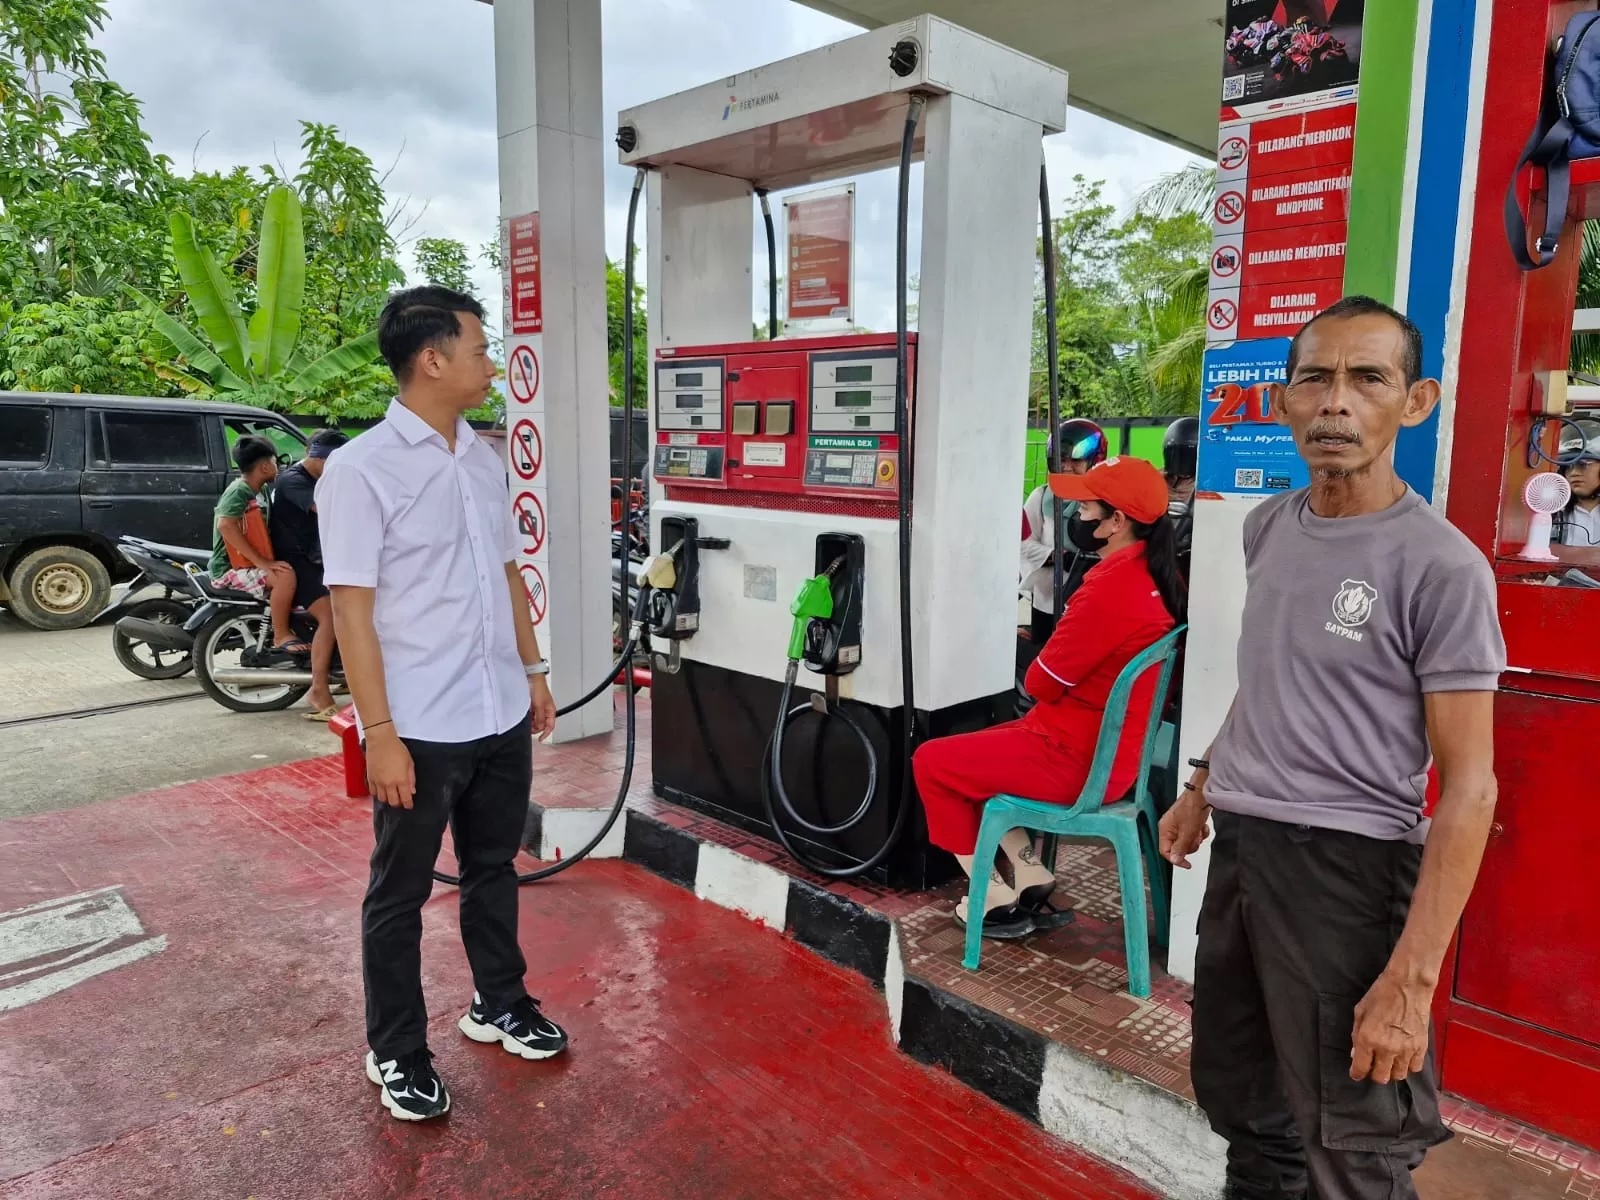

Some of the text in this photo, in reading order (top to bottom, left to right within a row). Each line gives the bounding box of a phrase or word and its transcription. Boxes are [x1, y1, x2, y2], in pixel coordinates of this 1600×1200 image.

[739, 91, 780, 111] PERTAMINA
[1257, 125, 1352, 154] DILARANG MEROKOK
[1251, 175, 1352, 202] DILARANG MENGAKTIFKAN
[1276, 197, 1324, 216] HANDPHONE
[1248, 242, 1346, 265] DILARANG MEMOTRET
[1270, 293, 1316, 309] DILARANG
[1253, 310, 1314, 327] MENYALAKAN
[1208, 368, 1260, 382] LEBIH
[814, 438, 873, 447] PERTAMINA DEX
[1324, 621, 1363, 642] SATPAM
